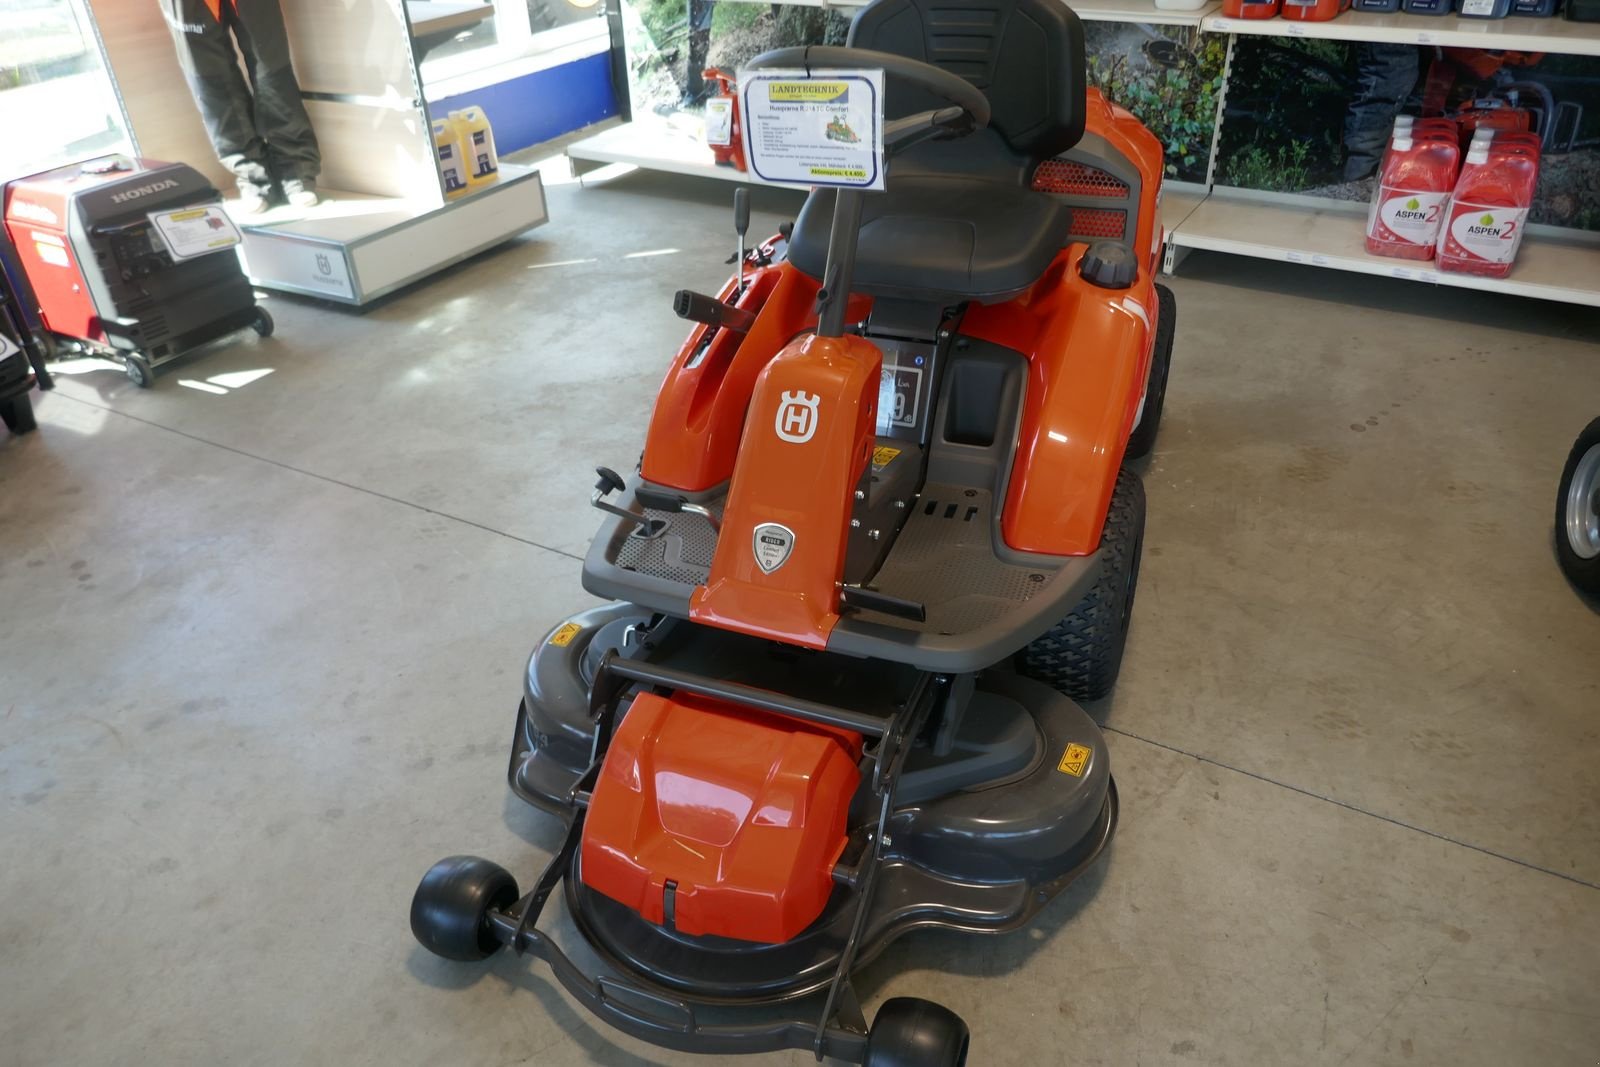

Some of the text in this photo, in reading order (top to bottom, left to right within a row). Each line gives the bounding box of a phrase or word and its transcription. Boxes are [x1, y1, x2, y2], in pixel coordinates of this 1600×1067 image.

[772, 85, 839, 94] LANDTECHNIK
[109, 179, 180, 204] HONDA
[1395, 205, 1441, 223] ASPEN 2
[1467, 221, 1516, 240] ASPEN 2
